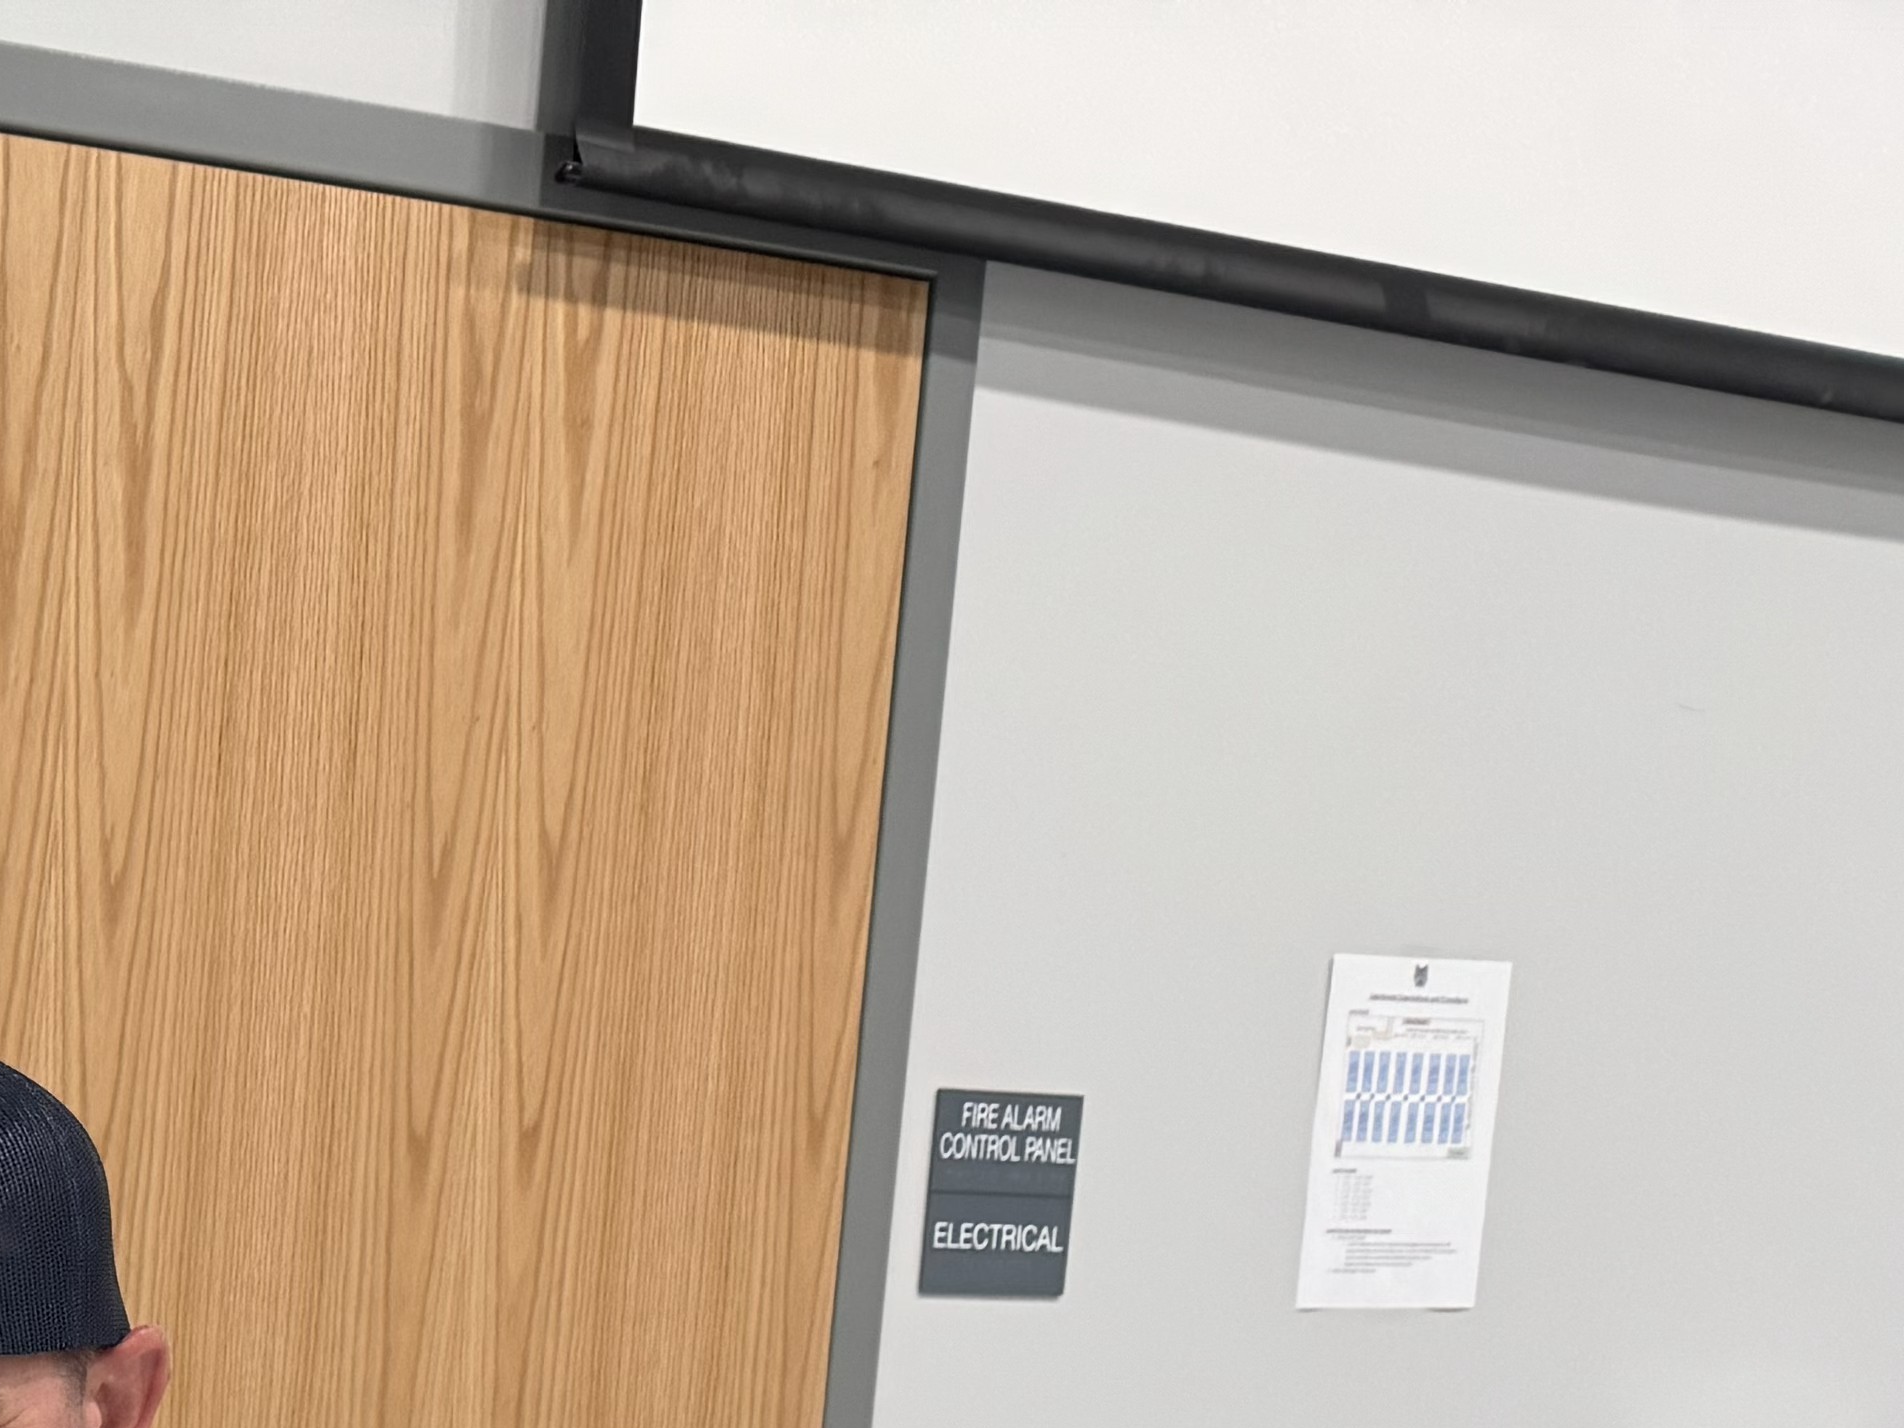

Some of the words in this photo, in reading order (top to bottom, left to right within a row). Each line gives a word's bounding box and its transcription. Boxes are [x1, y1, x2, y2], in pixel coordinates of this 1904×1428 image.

[961, 1101, 1000, 1130] FIRE
[1000, 1104, 1062, 1132] ALARM
[940, 1132, 1021, 1162] CONTROL
[1024, 1136, 1077, 1165] PANEL
[932, 1221, 1064, 1253] ELECTRICAL
